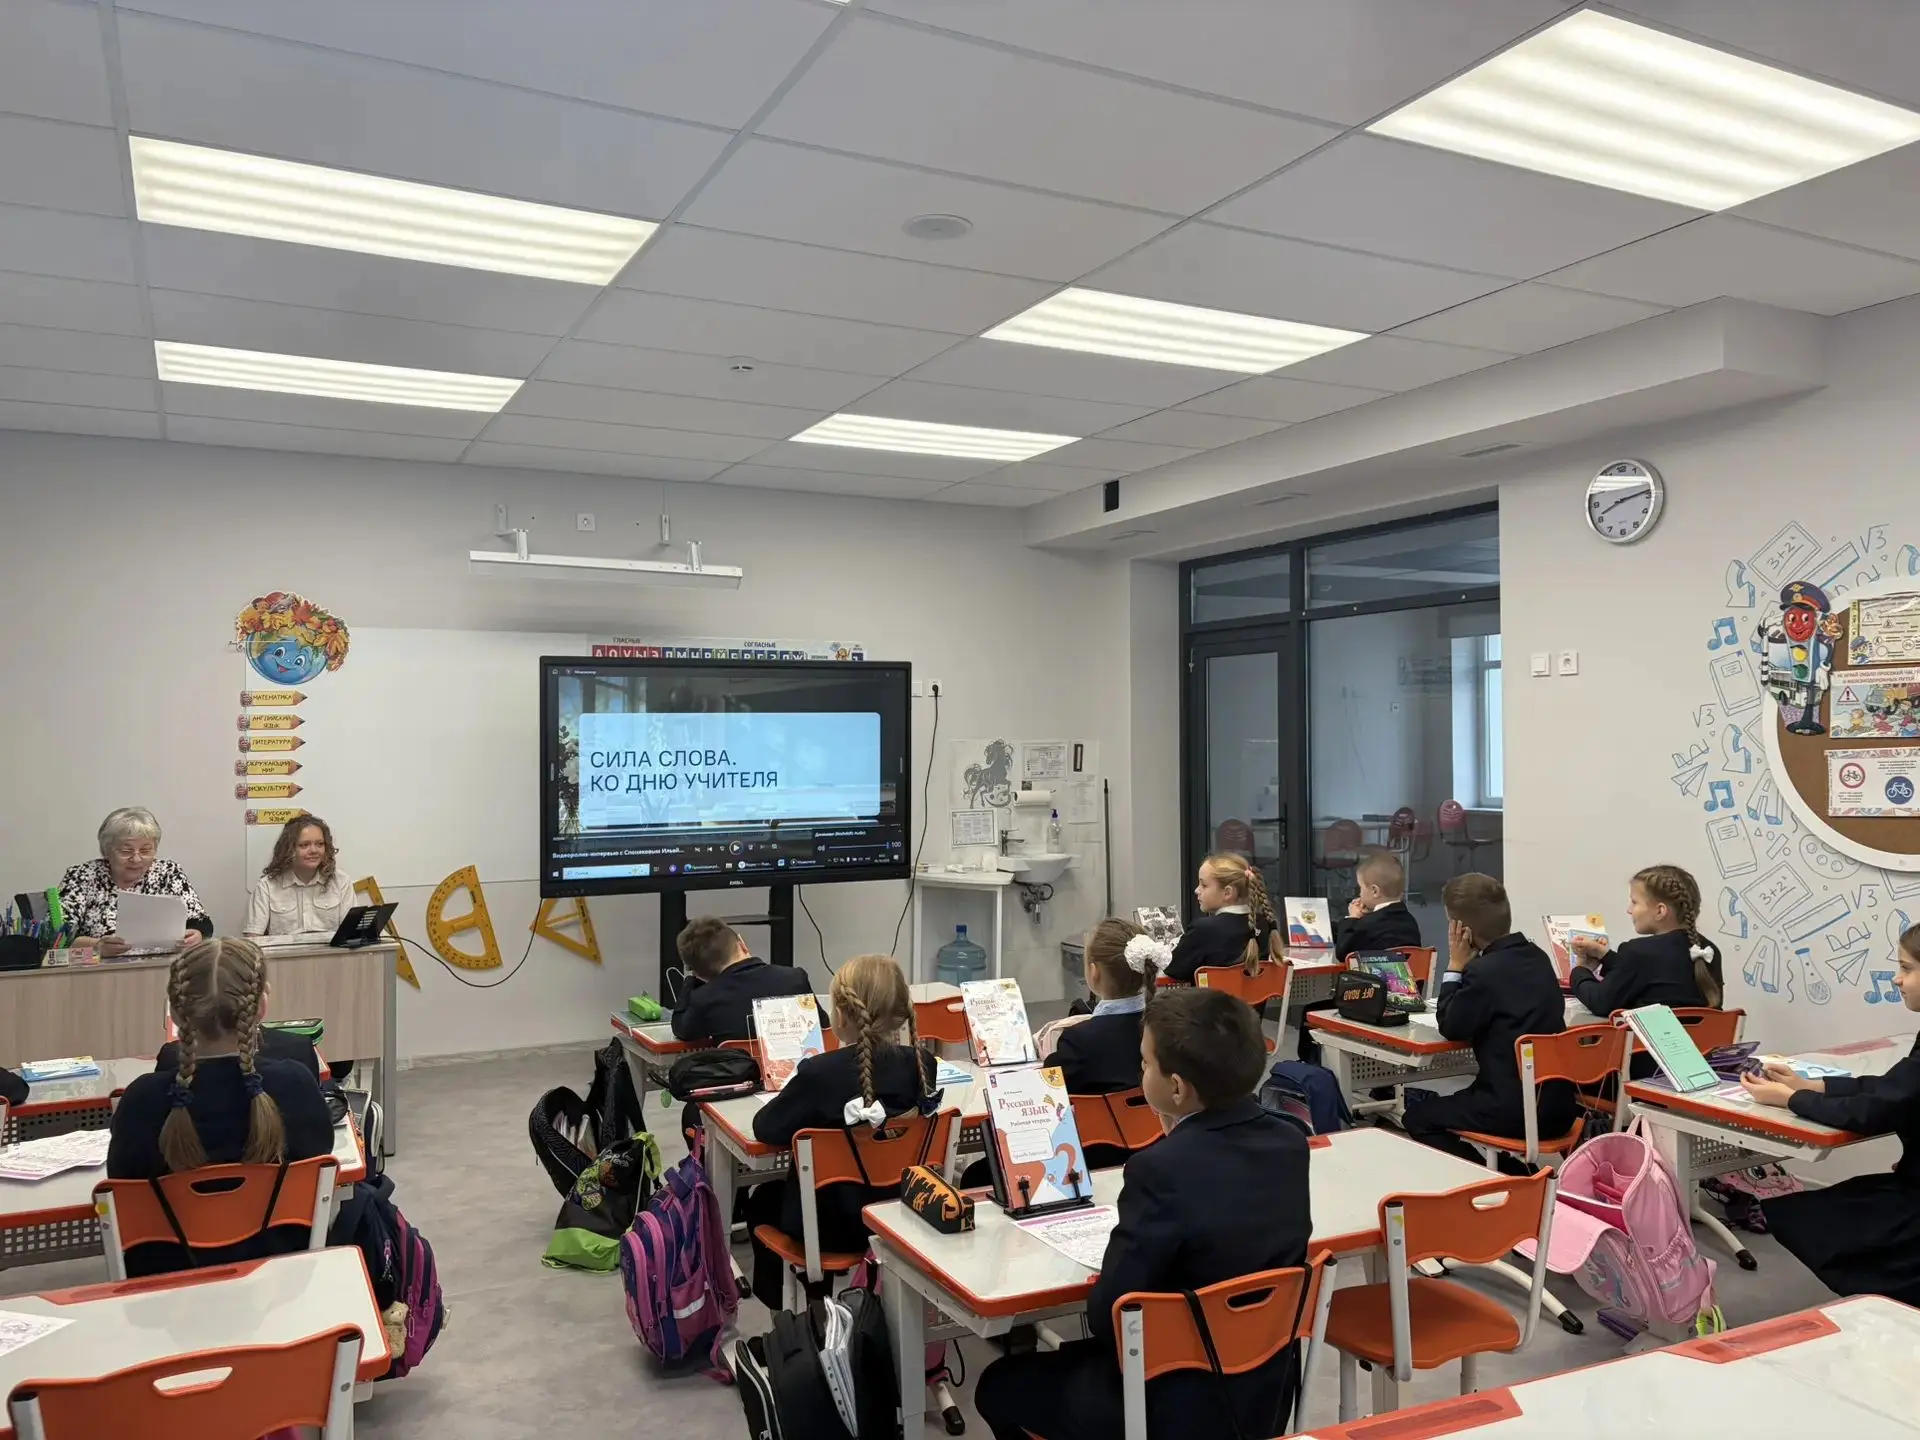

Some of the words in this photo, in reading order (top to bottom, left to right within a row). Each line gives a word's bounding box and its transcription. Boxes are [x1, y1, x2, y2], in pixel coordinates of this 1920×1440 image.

[590, 751, 651, 768] СИЛА
[658, 750, 737, 767] СЛОВА.
[591, 774, 619, 792] КО
[625, 773, 678, 794] ДНЮ
[684, 771, 778, 790] УЧИТЕЛЯ
[997, 1097, 1035, 1111] Русский
